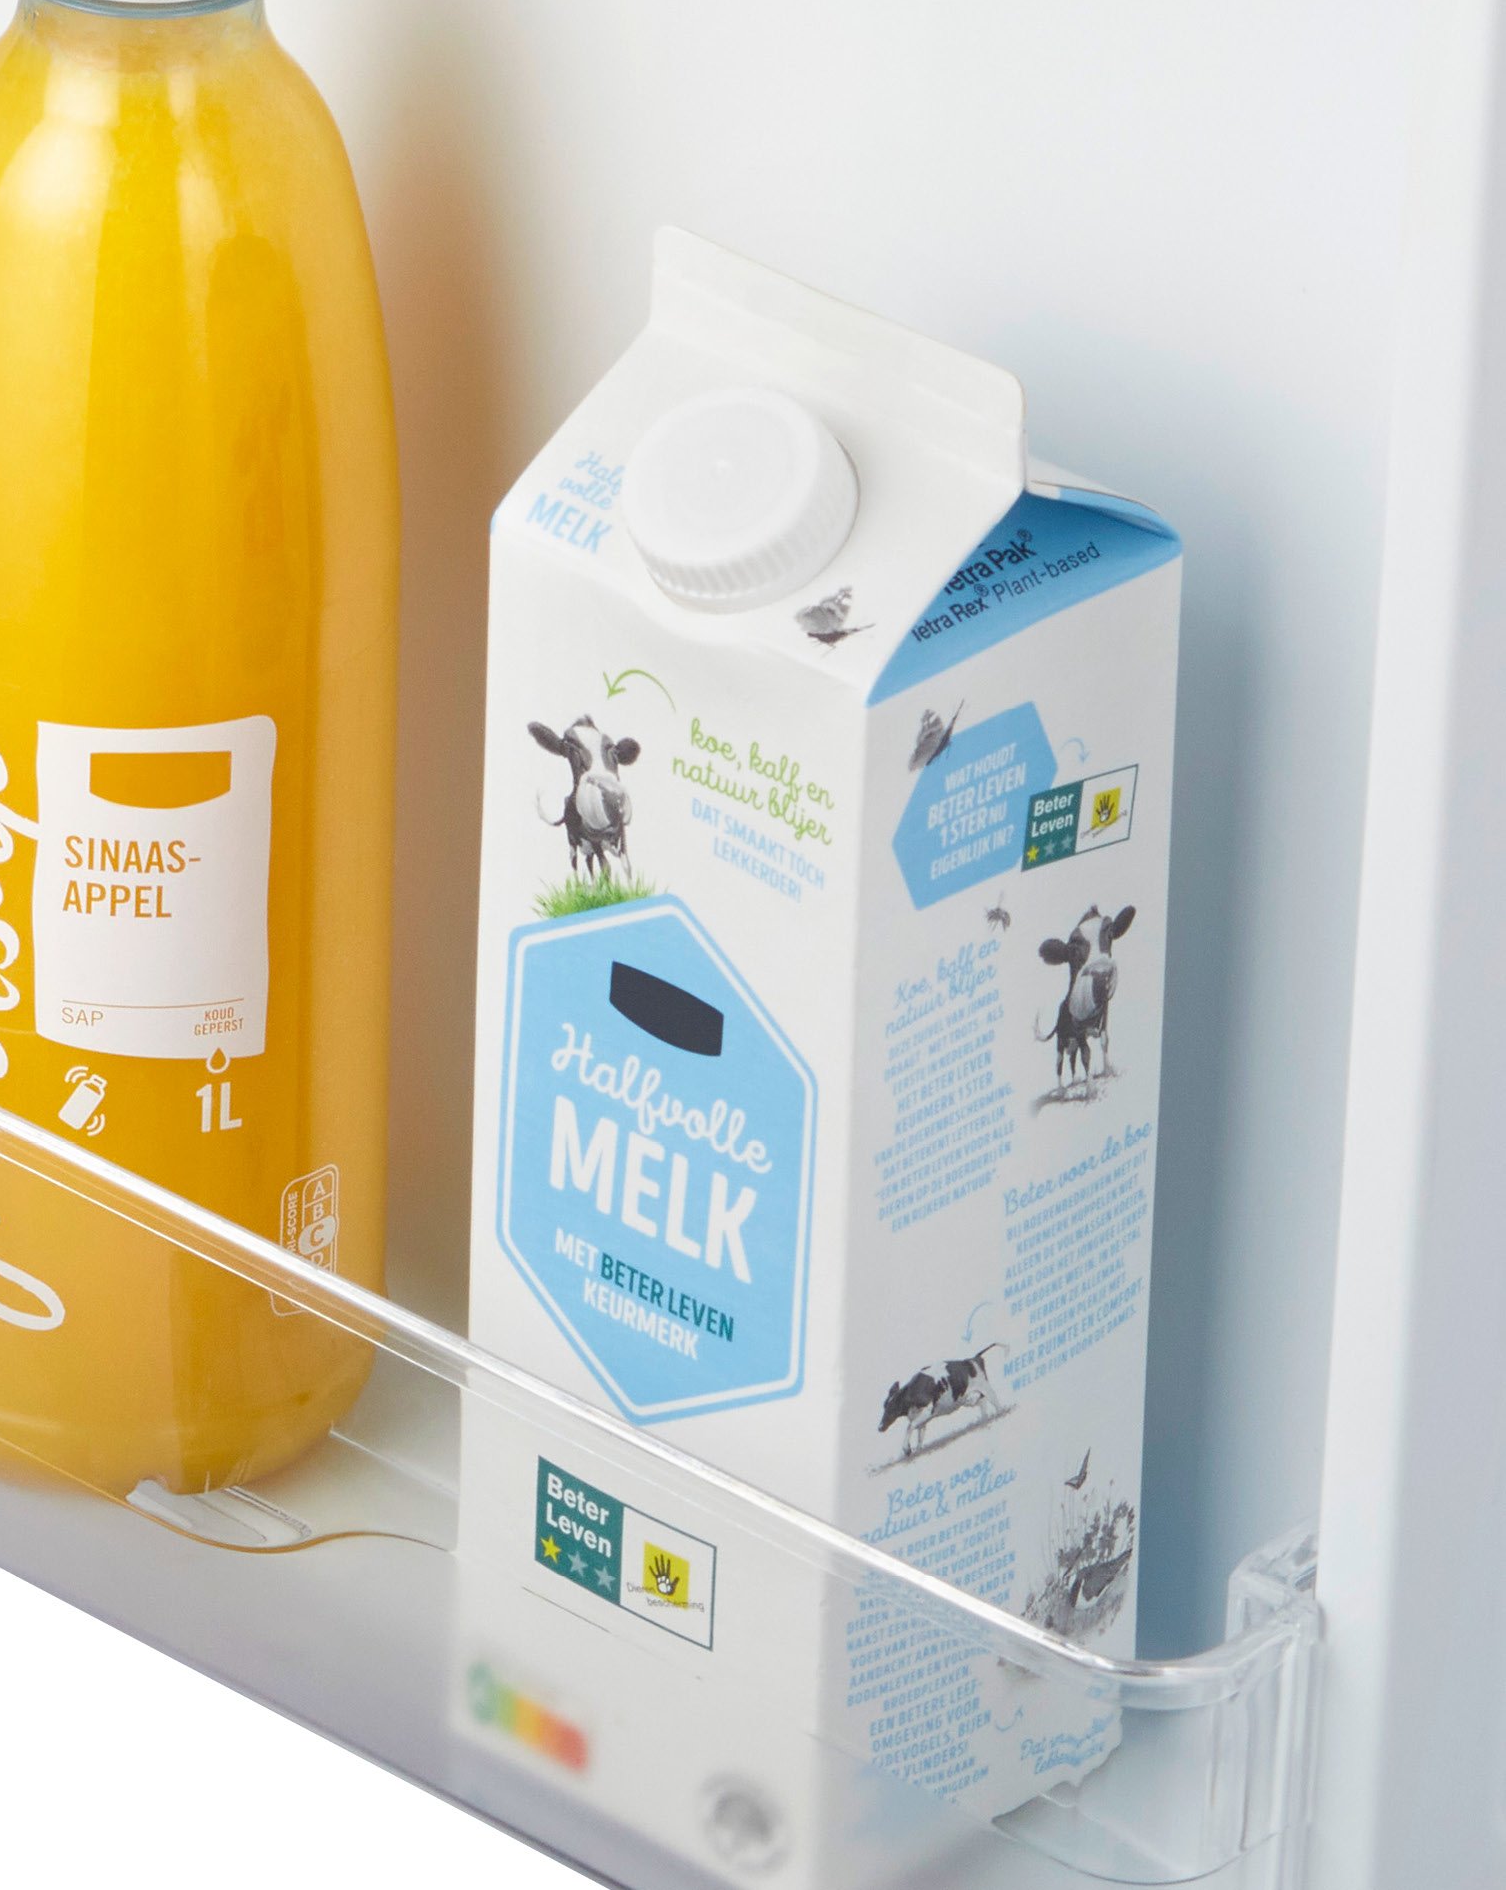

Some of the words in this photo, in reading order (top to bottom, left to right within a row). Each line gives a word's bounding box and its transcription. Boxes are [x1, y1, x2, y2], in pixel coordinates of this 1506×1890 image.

[558, 477, 613, 510] volle
[525, 492, 613, 554] MELK
[991, 541, 1101, 603] Plant-based
[691, 716, 742, 771] koe,
[749, 741, 803, 802] kalf
[807, 781, 835, 810] en
[944, 762, 973, 793] WAT
[973, 742, 1018, 780] HOUDT
[672, 757, 764, 810] natuur
[768, 786, 833, 846] blijer
[927, 788, 977, 830] BETER
[977, 762, 1027, 806] LEVEN
[1033, 792, 1076, 818] Beter
[691, 797, 721, 828] DAT
[724, 814, 786, 865] SMAAKT
[940, 825, 948, 849] 1
[949, 809, 988, 846] STER
[989, 800, 1008, 825] NU
[1030, 813, 1075, 839] Leven
[64, 835, 202, 876] SINAAS-
[713, 835, 802, 904] LEKKERDER!
[930, 837, 991, 881] EIGENLIJK
[992, 824, 1016, 852] IN?
[62, 879, 173, 919] APPEL
[977, 938, 1002, 961] en
[60, 1006, 105, 1027] SAP
[193, 1017, 244, 1037] GEPERST
[204, 1007, 236, 1024] KOUD
[884, 993, 945, 1039] natuur
[194, 1081, 244, 1133] 1L
[550, 1021, 773, 1174] Halfvolle
[312, 1180, 326, 1200] A
[549, 1094, 757, 1285] MELK
[1003, 1178, 1057, 1215] Beter
[1058, 1155, 1099, 1189] voor
[1100, 1135, 1123, 1164] de
[1123, 1121, 1153, 1151] koe
[309, 1223, 325, 1247] C
[312, 1202, 325, 1221] B
[554, 1226, 600, 1273] MET
[599, 1251, 665, 1309] BETER
[667, 1286, 735, 1343] LEVEN
[582, 1276, 699, 1361] KEURMERK
[546, 1471, 611, 1526] Beter
[886, 1479, 947, 1516] Beter
[949, 1458, 996, 1490] voor
[955, 1467, 1017, 1509] milieu
[545, 1501, 613, 1559] Leven
